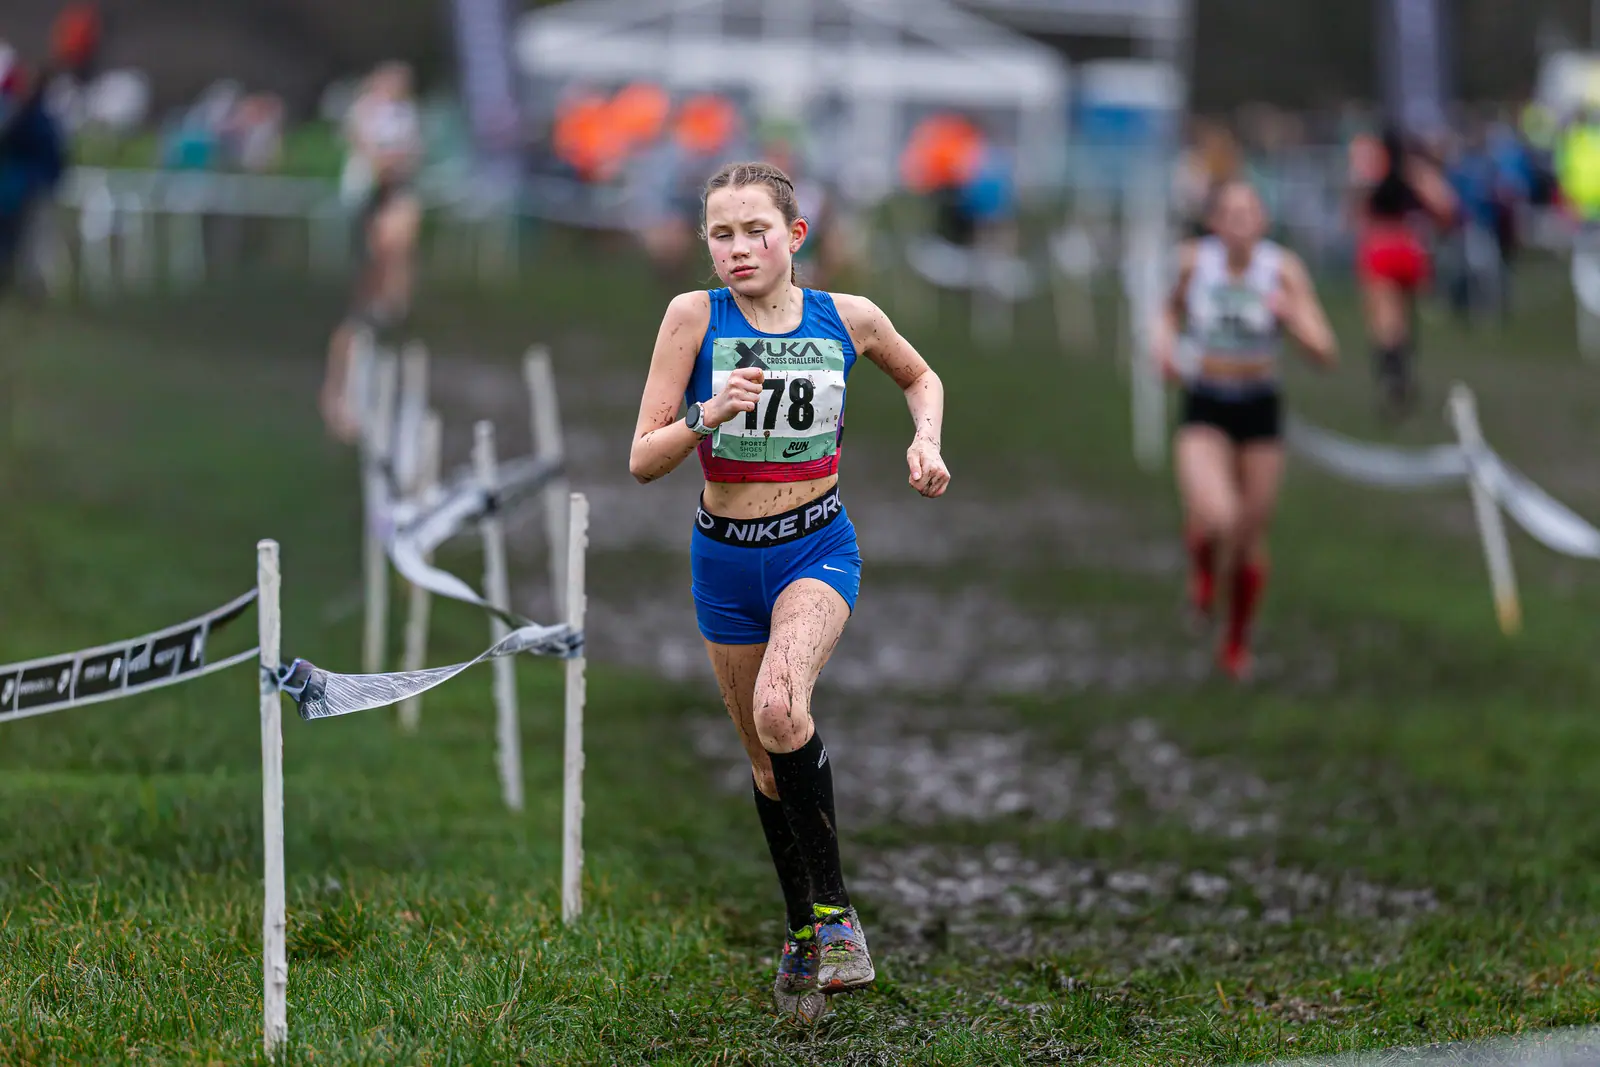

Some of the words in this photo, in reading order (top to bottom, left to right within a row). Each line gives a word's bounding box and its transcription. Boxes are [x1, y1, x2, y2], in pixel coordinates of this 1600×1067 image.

[767, 357, 787, 365] CROSS
[788, 356, 824, 365] CHALLENGE
[788, 441, 809, 451] RUN
[725, 515, 798, 542] NIKE
